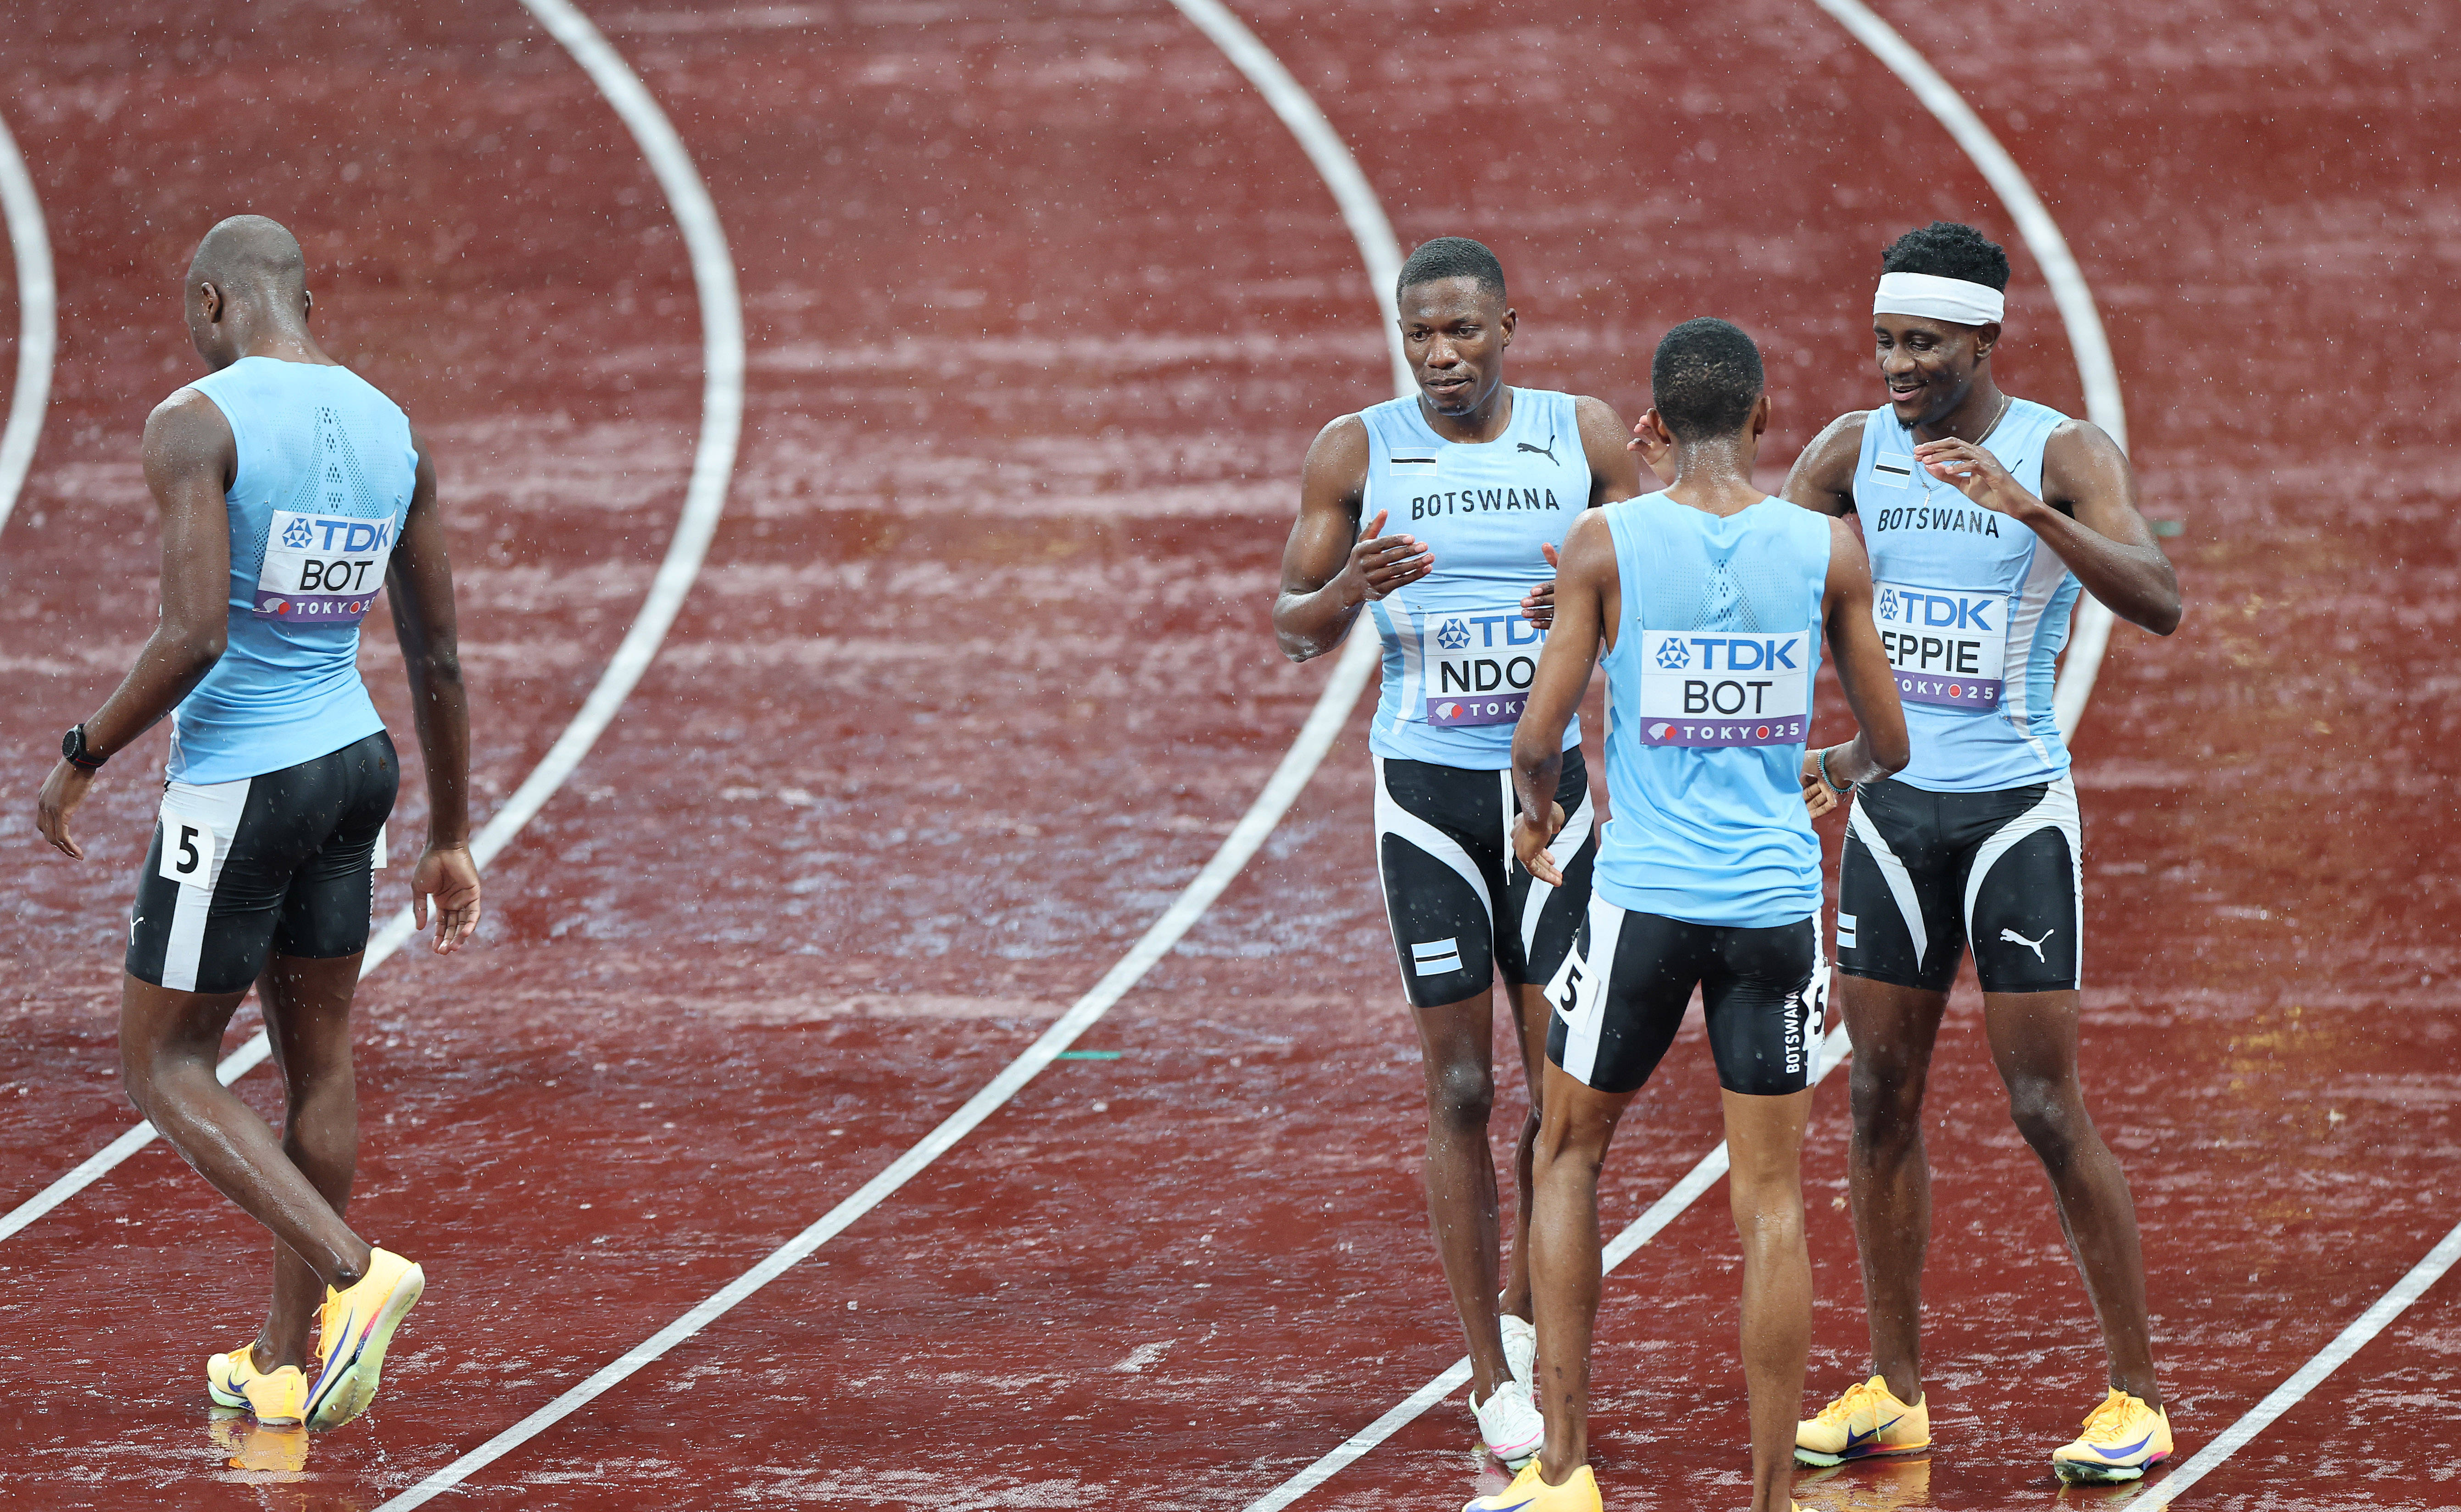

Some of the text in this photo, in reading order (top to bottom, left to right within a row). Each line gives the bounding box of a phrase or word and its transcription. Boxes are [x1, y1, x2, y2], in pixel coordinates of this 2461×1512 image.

[1412, 488, 1560, 520] BOTSWANA
[315, 518, 393, 551] TDK
[1878, 507, 1999, 538] BOTSWANA
[299, 560, 373, 591] BOT
[1899, 592, 1993, 631] TDK
[1470, 615, 1547, 647] TD
[1691, 638, 1798, 670] TDK
[1684, 680, 1772, 714] BOT
[176, 825, 199, 874] 5
[1560, 964, 1583, 1012] 5
[1814, 984, 1824, 1035] 5
[1784, 990, 1799, 1074] BOTSWANA
